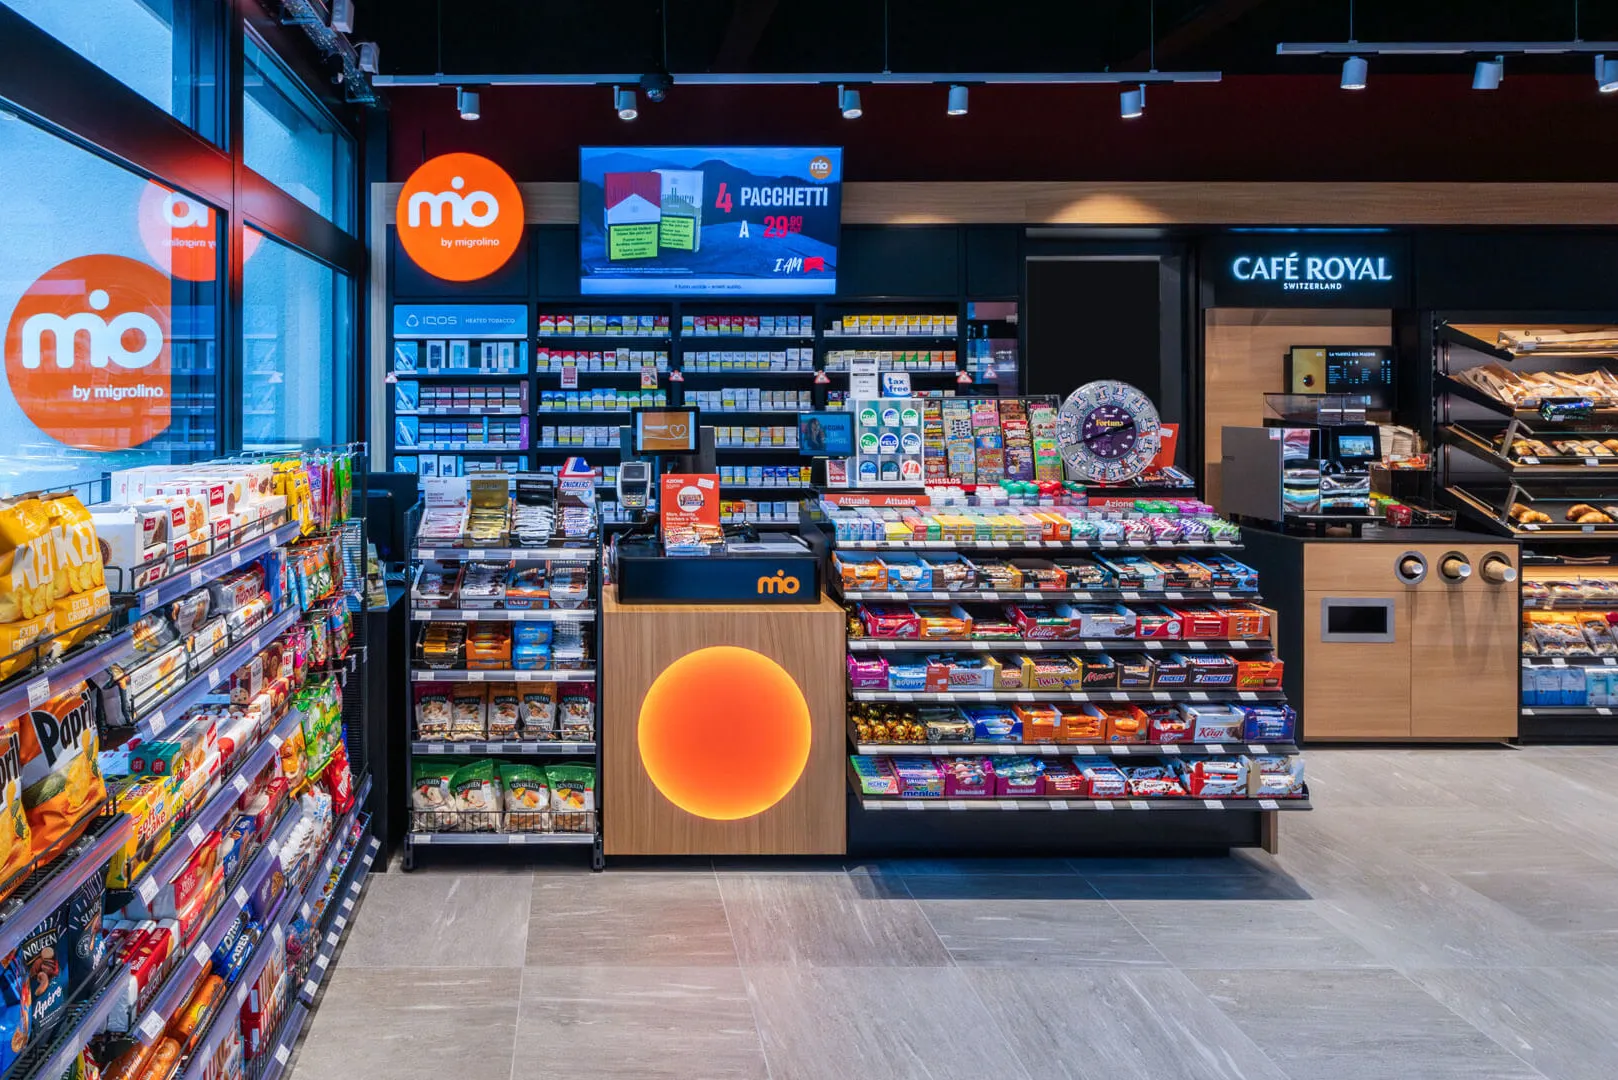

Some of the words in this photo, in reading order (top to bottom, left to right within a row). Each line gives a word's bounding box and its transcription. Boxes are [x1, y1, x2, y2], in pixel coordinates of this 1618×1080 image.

[810, 159, 828, 170] mio
[408, 176, 500, 228] mio
[715, 183, 733, 213] 4
[741, 187, 828, 206] PACCHETTI
[738, 220, 750, 238] A
[440, 238, 454, 249] by
[455, 237, 500, 249] migrolino
[1233, 252, 1299, 280] CAFÉ
[1306, 257, 1393, 280] ROYAL
[422, 316, 457, 325] IQOS
[22, 289, 164, 369] mio
[889, 377, 904, 385] tax
[72, 384, 91, 401] by
[94, 384, 164, 401] migrolino
[889, 385, 909, 393] free
[561, 480, 591, 489] SNICKERS
[839, 496, 870, 505] Attuale
[885, 497, 916, 506] Attuale
[1104, 499, 1134, 508] Azione
[757, 569, 800, 594] mio
[1158, 675, 1186, 683] SNICKERS
[1201, 675, 1233, 683] SNICKERS
[1198, 727, 1225, 738] Kägi
